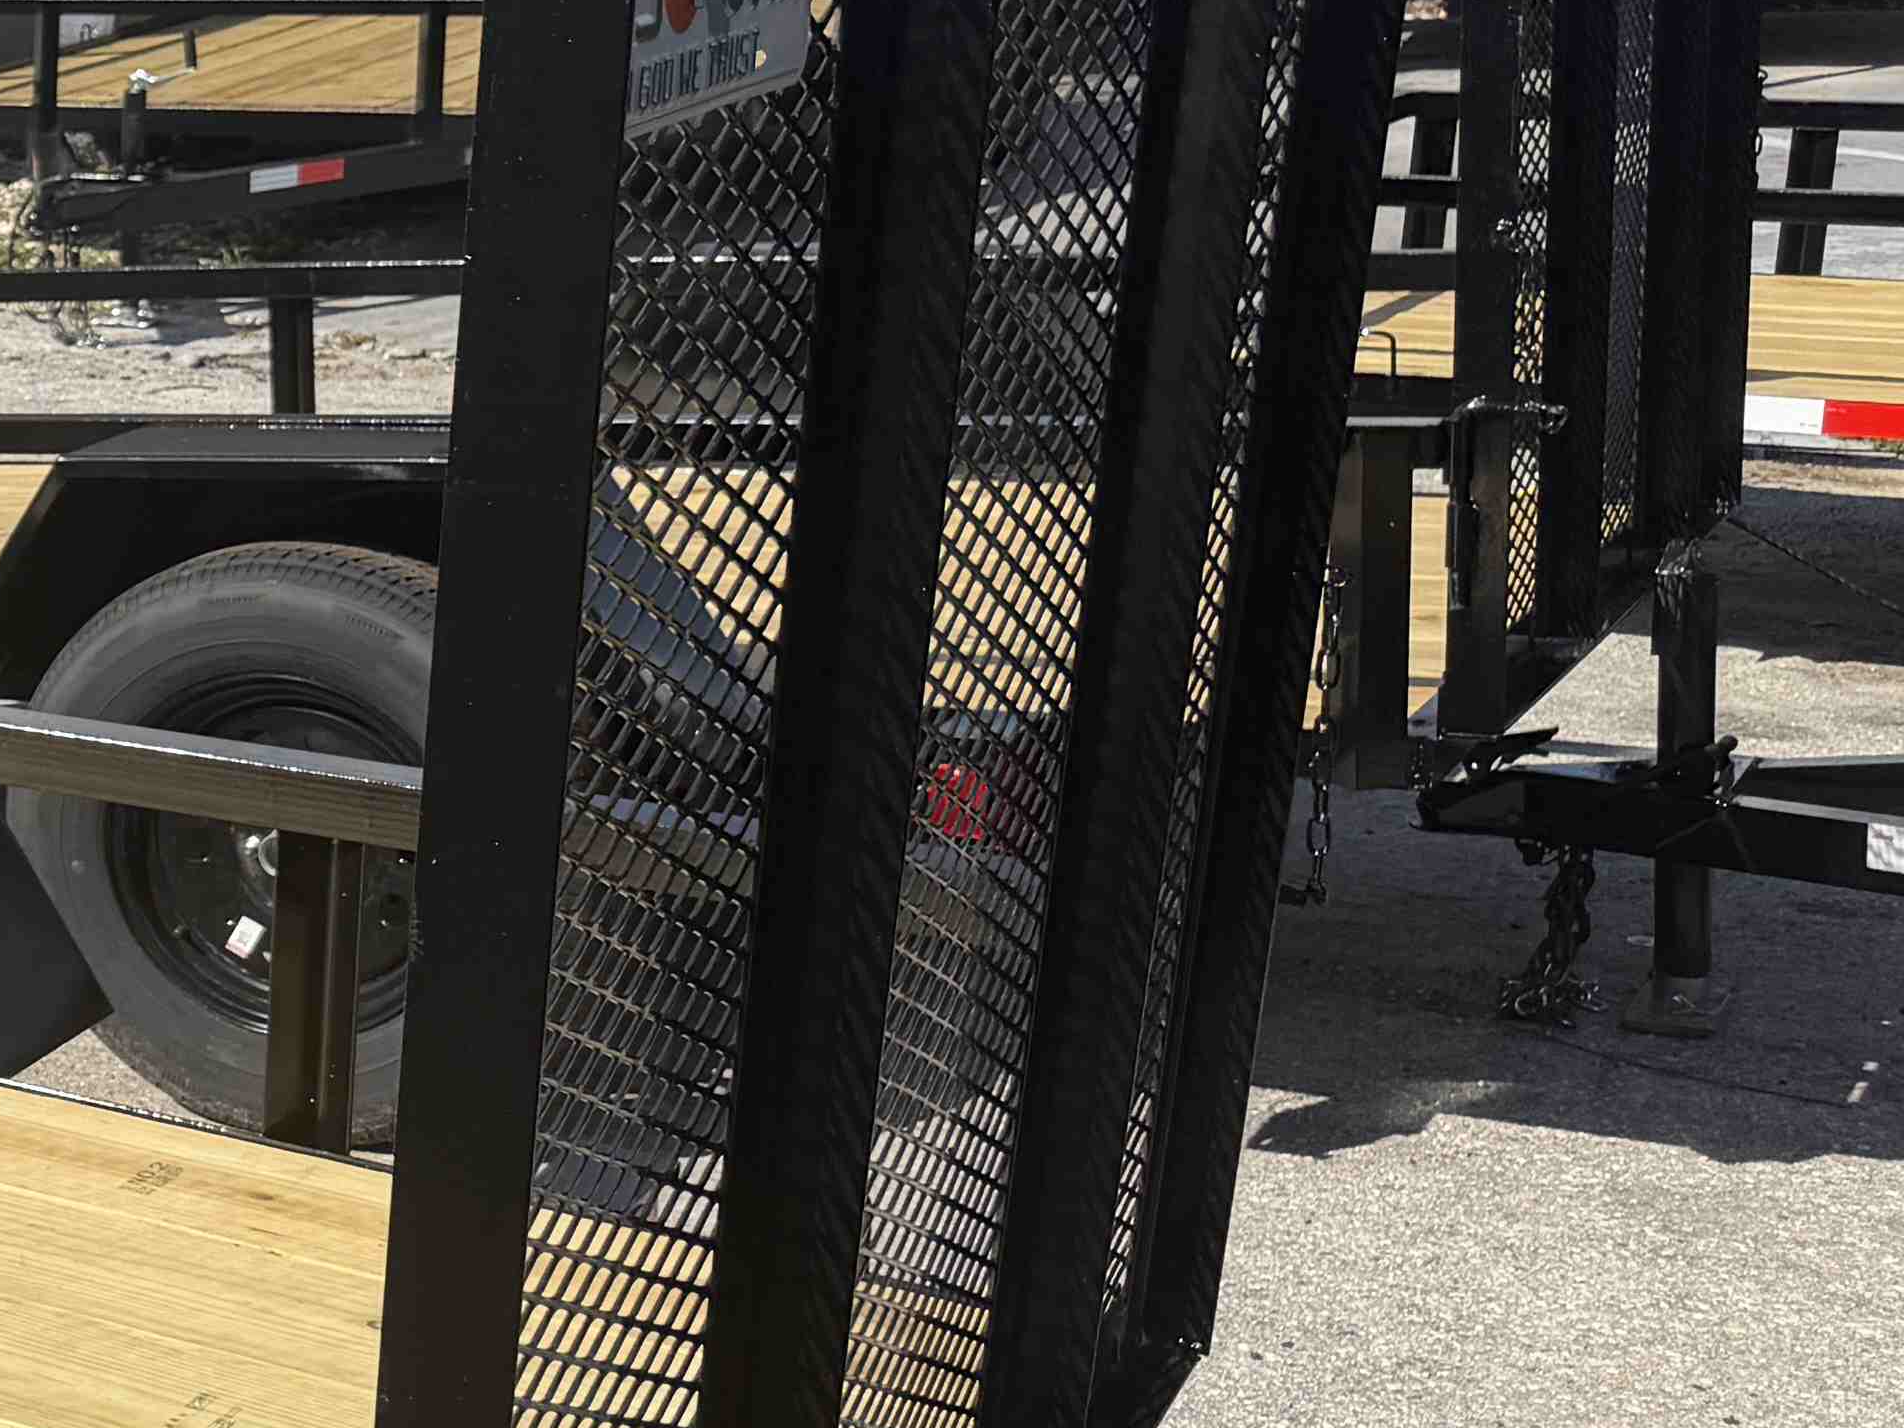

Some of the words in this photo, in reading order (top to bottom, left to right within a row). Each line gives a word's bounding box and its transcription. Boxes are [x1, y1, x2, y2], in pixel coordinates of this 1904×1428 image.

[639, 57, 674, 109] GOD
[679, 46, 703, 96] WE
[707, 27, 761, 88] TRUST
